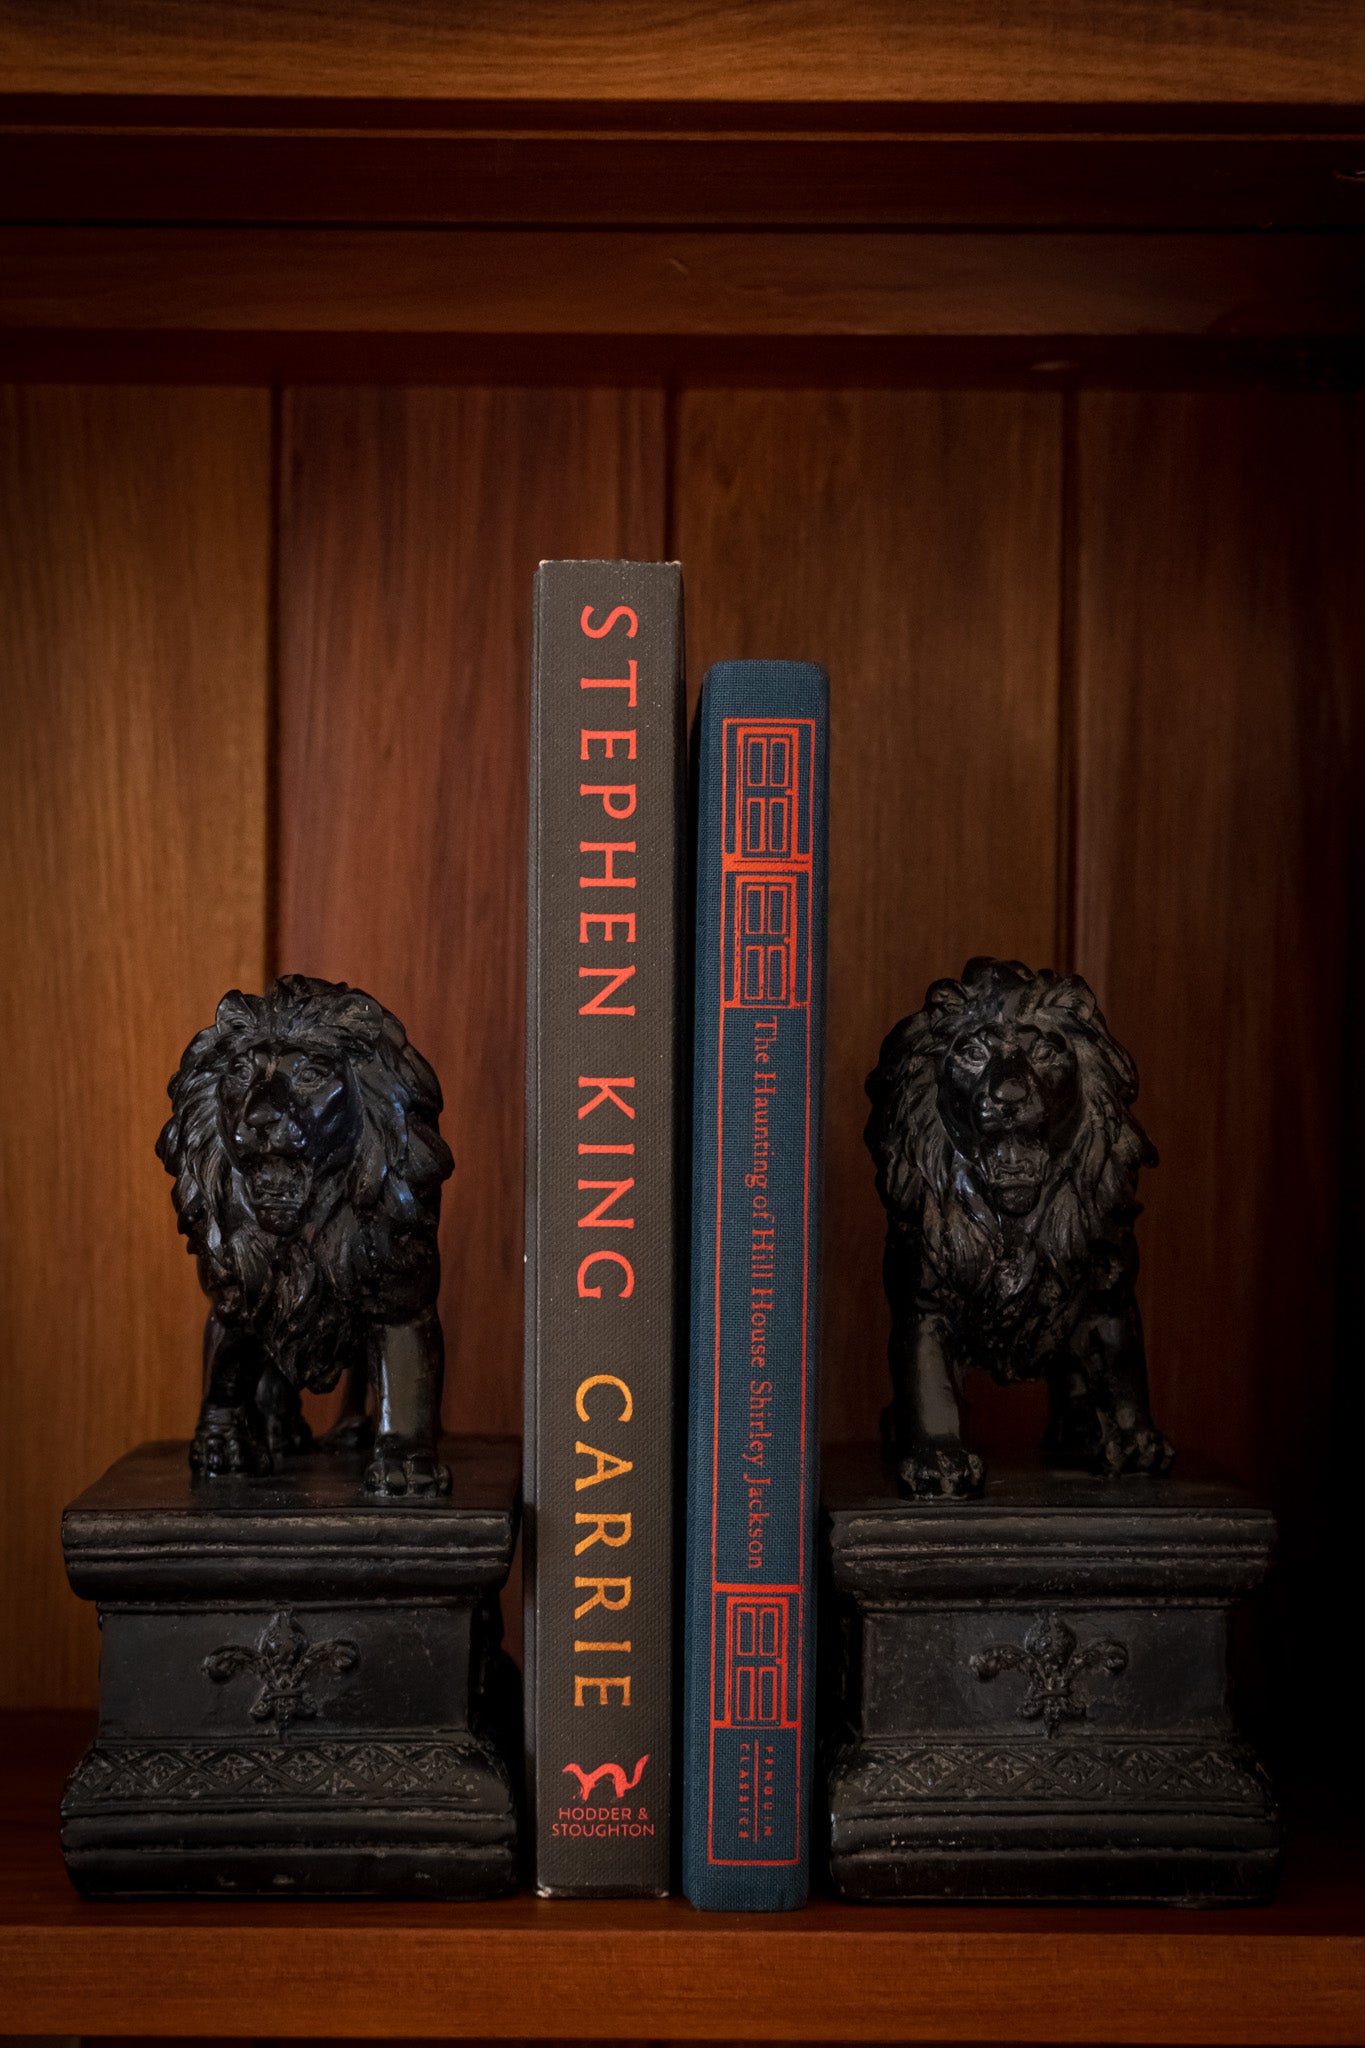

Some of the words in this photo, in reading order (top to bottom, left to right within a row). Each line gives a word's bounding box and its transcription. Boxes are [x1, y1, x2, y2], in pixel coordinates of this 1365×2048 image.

[577, 604, 639, 1017] STEPHEN
[754, 1015, 778, 1064] The
[744, 1071, 777, 1189] Haunting
[576, 1075, 636, 1300] KING
[752, 1195, 775, 1224] of
[751, 1228, 775, 1279] Hill
[751, 1287, 773, 1369] House
[741, 1380, 773, 1467] Shirley
[573, 1373, 634, 1707] CARRIE
[743, 1472, 771, 1570] Jackson
[551, 1823, 655, 1837] STOUGHTON
[558, 1807, 632, 1821] HODDER
[637, 1807, 649, 1820] &
[738, 1743, 750, 1838] CLASSICS
[763, 1745, 774, 1836] PENGUIN
